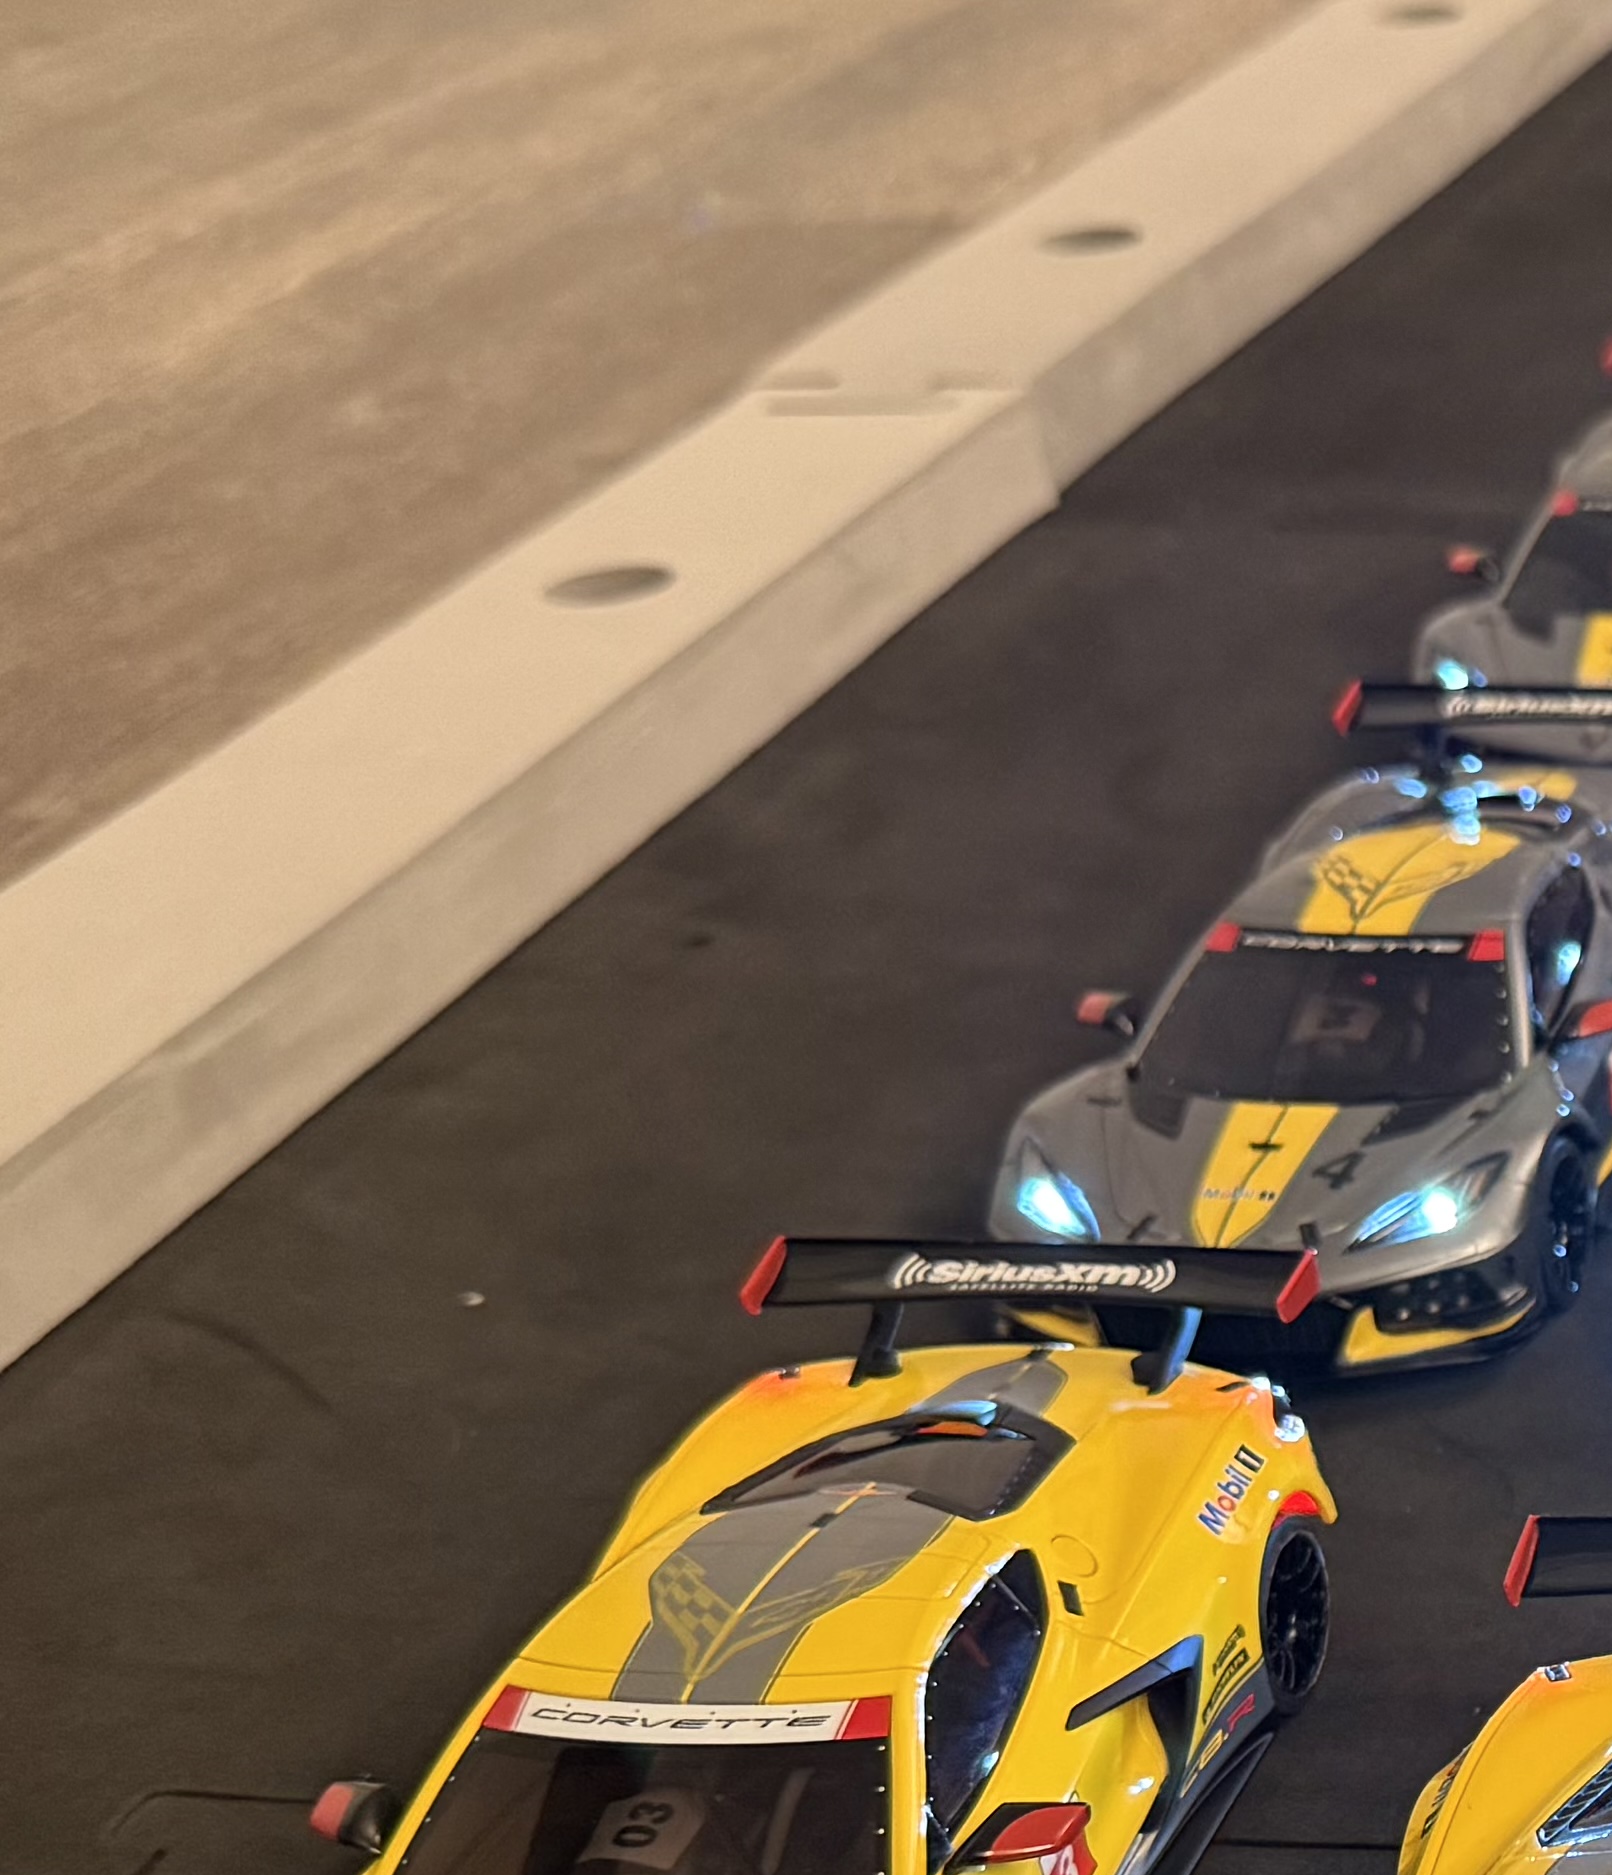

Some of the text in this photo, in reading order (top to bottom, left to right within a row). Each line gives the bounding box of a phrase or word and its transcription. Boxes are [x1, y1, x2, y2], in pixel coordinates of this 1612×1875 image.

[1312, 1150, 1367, 1191] 4
[1197, 1463, 1253, 1537] Mobil
[530, 1706, 833, 1731] CORVETTE
